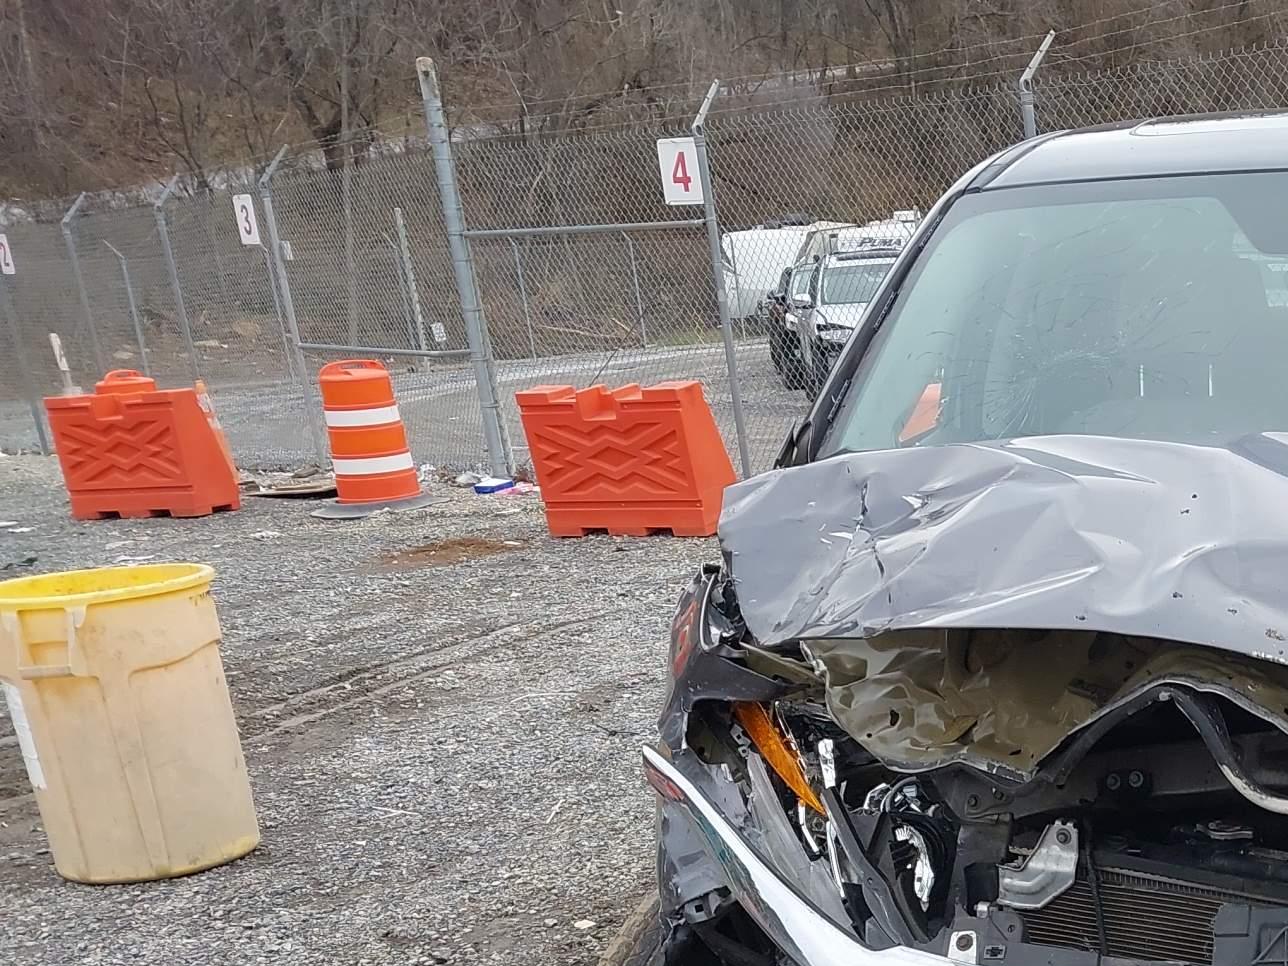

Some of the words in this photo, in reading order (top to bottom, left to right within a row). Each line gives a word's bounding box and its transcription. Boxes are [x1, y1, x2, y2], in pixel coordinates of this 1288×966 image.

[672, 151, 692, 193] 4
[240, 204, 252, 236] 3
[857, 237, 902, 247] PUMA
